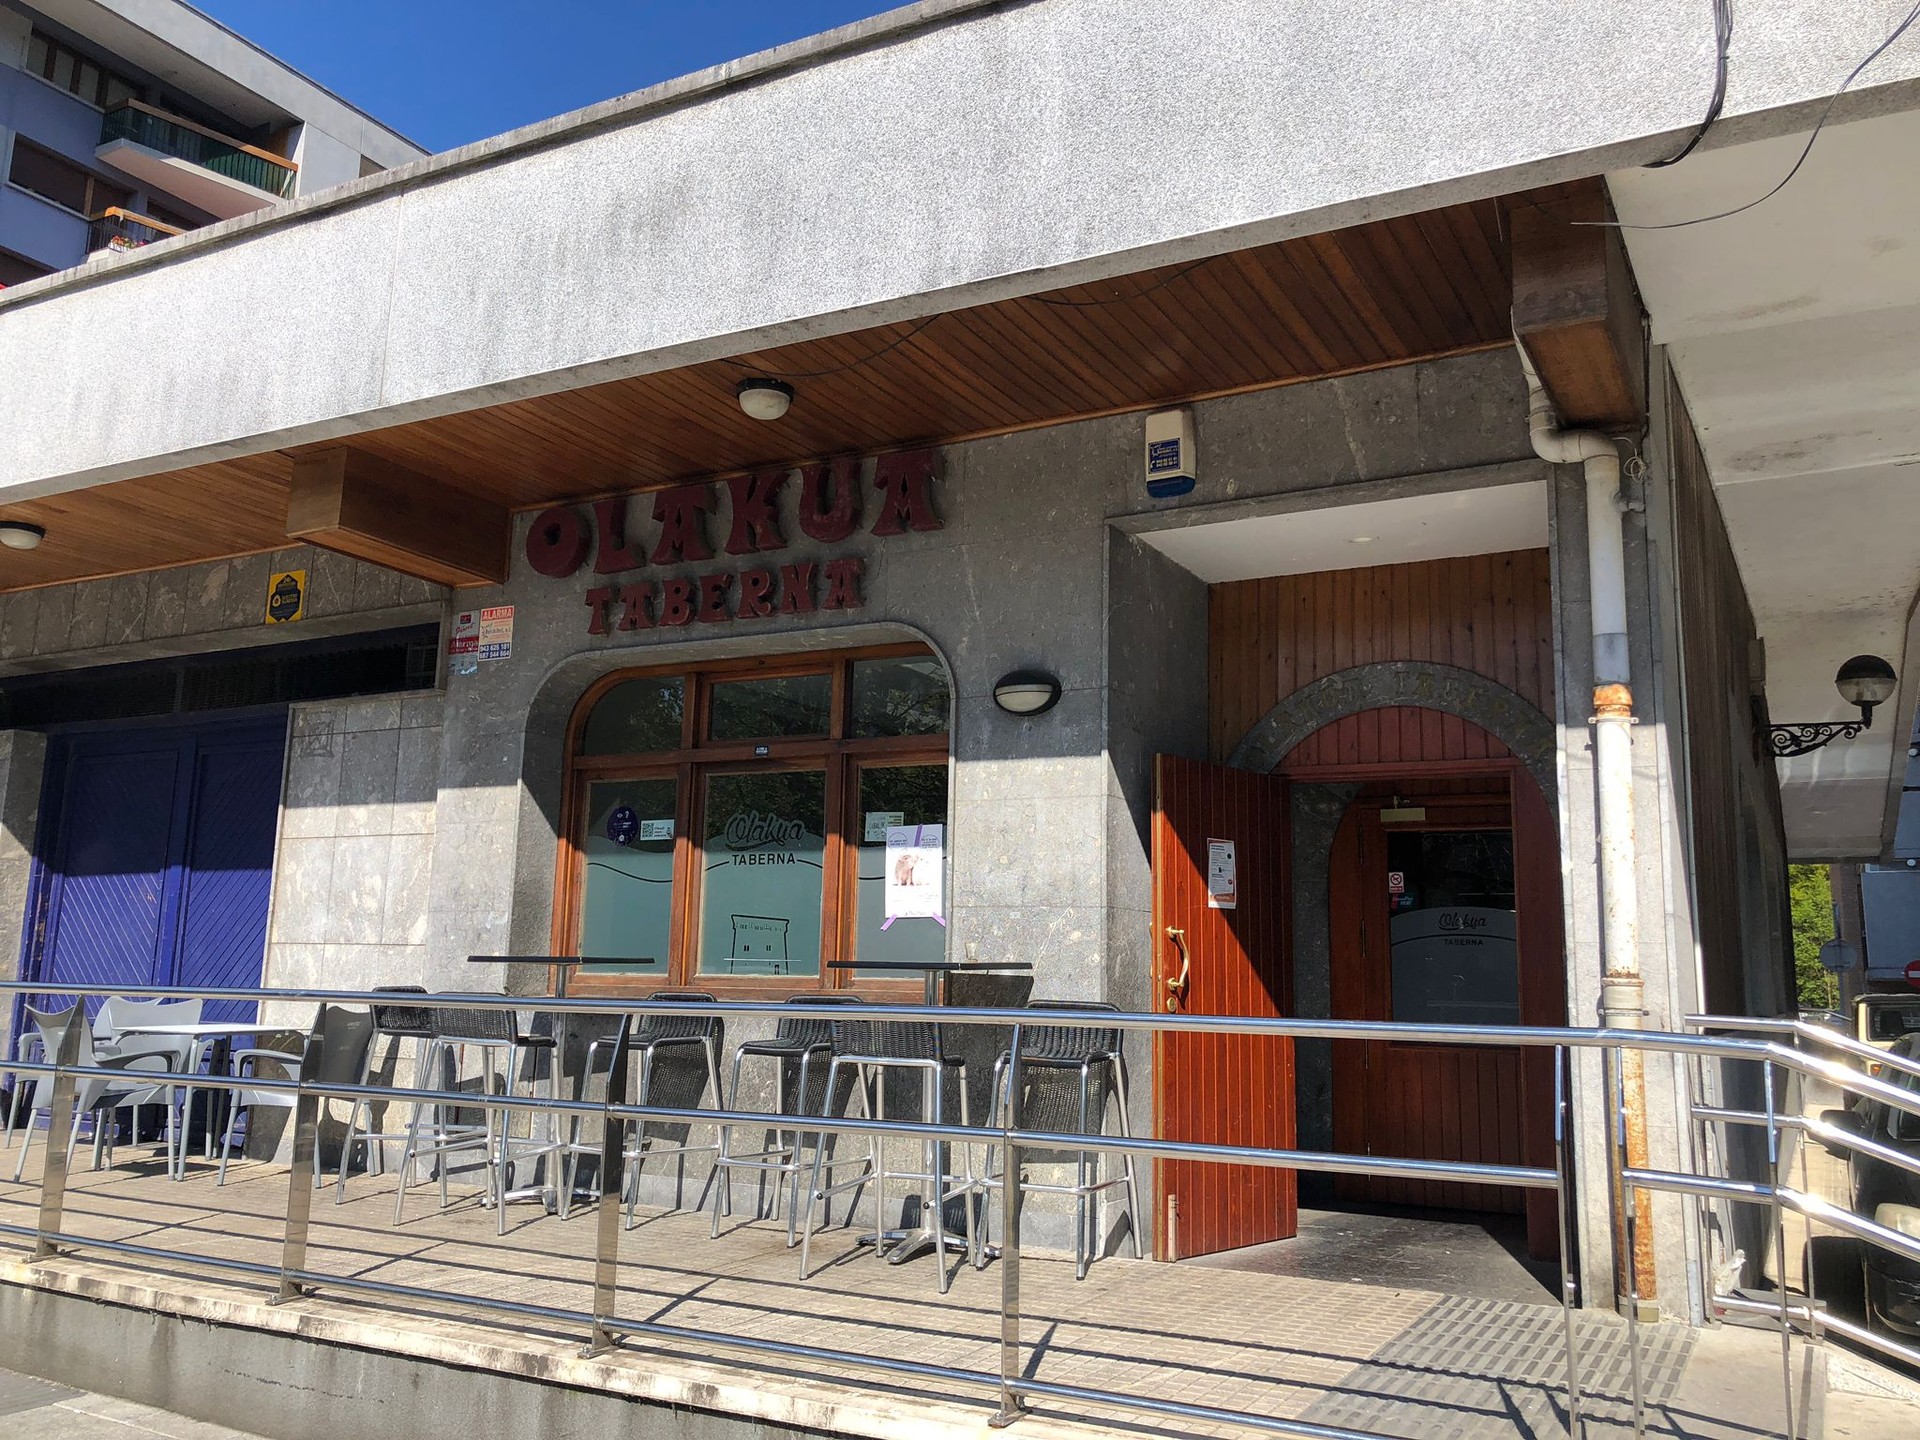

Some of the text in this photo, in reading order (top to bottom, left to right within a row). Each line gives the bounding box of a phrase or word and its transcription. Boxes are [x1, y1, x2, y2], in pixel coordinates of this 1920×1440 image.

[527, 449, 943, 578] OLAKUA
[482, 608, 512, 620] ALARMA
[585, 557, 865, 637] TABERNA
[724, 809, 806, 851] Olakua
[732, 852, 796, 866] TABERNA
